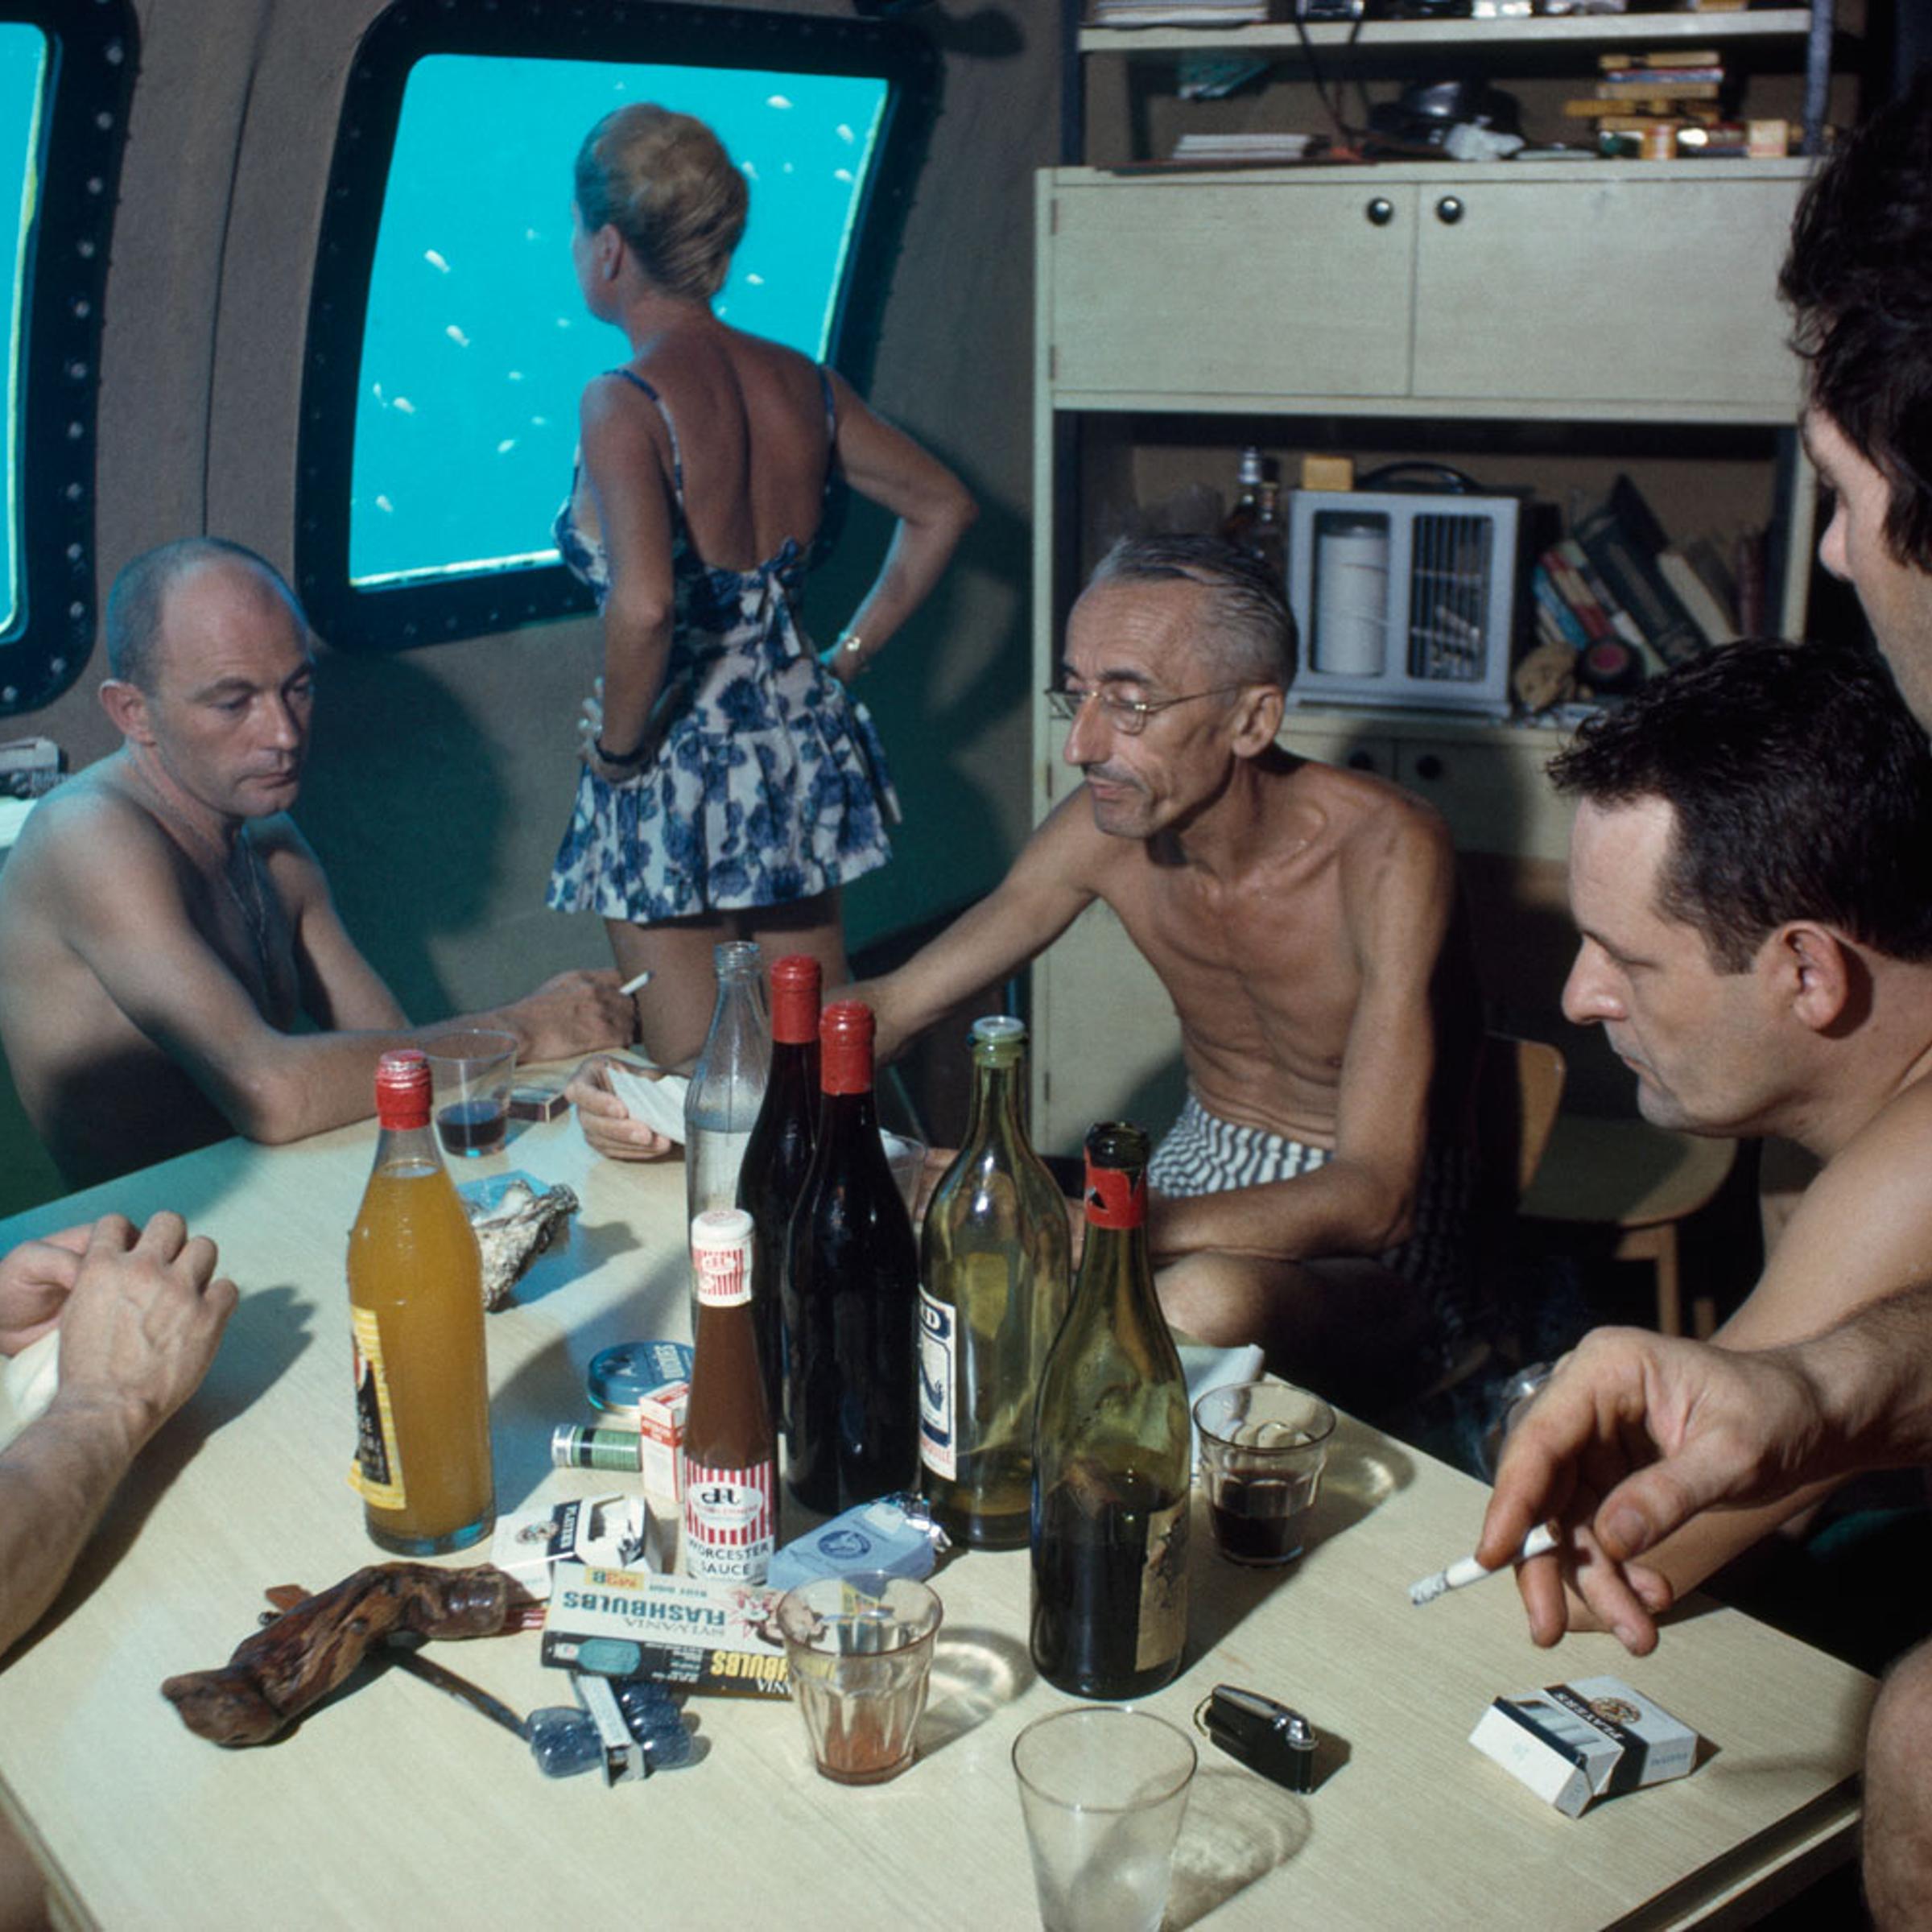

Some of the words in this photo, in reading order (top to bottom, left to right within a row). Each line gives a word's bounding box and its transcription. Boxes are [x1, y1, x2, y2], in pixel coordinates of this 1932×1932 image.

[689, 1538, 769, 1561] WORCESTER
[701, 1561, 750, 1575] SAUCE
[563, 1591, 725, 1626] FLASHBULBS
